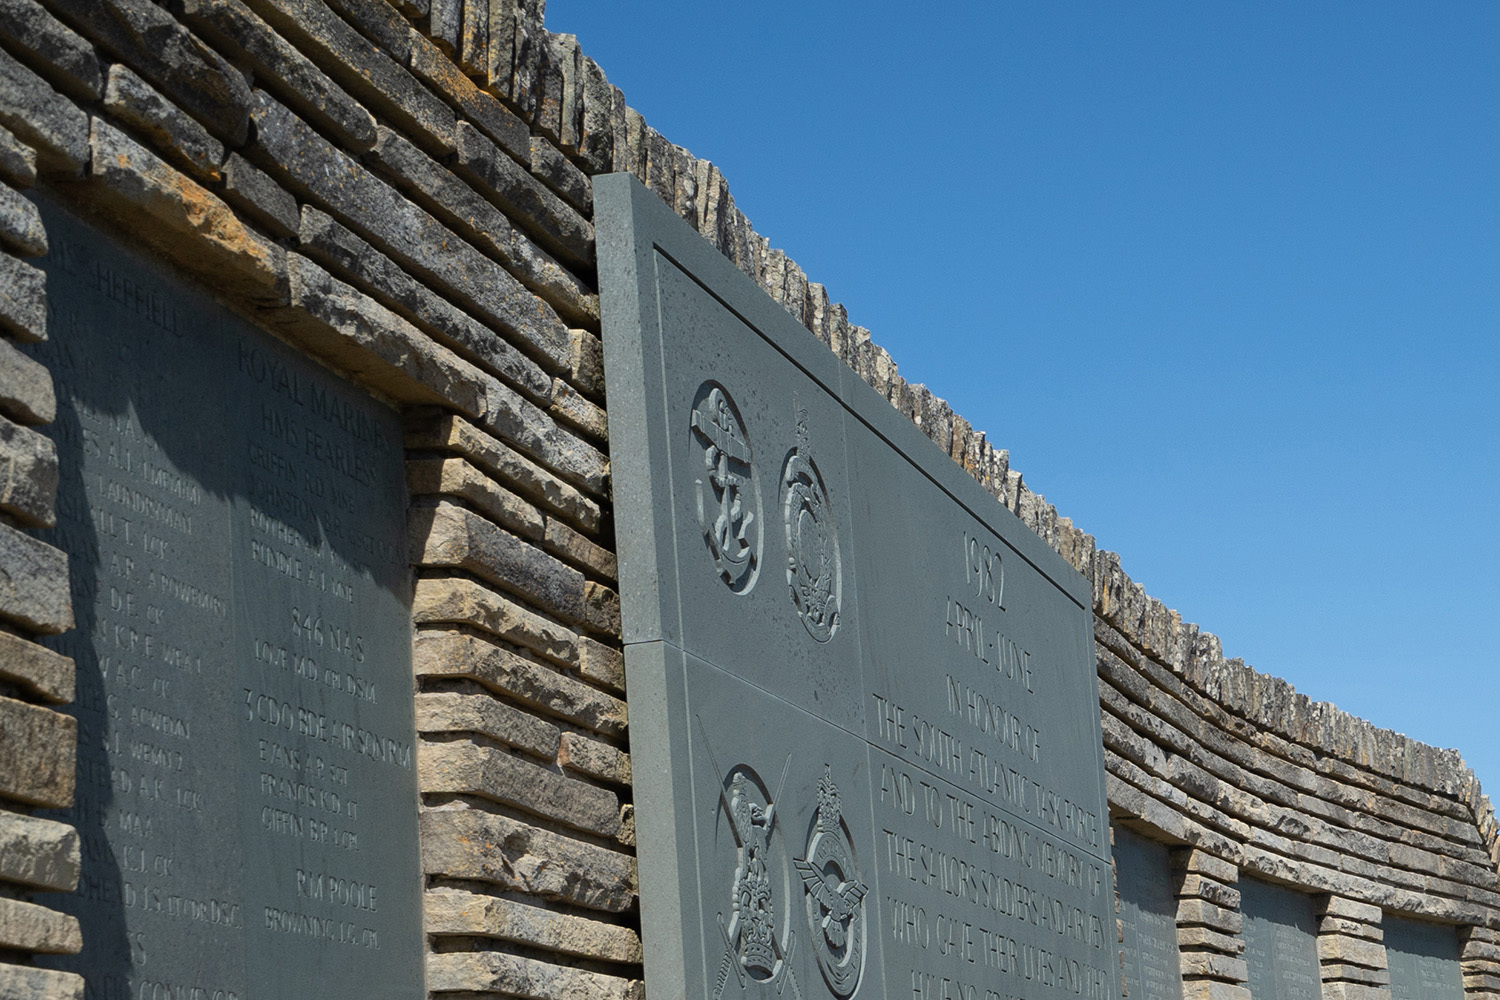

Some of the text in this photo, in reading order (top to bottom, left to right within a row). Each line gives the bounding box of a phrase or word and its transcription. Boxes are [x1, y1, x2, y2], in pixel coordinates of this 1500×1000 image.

[236, 337, 305, 408] ROYAL
[260, 400, 300, 450] HMS
[246, 438, 298, 484] GRIFFIN
[97, 471, 192, 535] LAUNDRYMAN
[250, 537, 304, 583] RUNDLE
[962, 529, 1008, 613] 1982
[253, 635, 289, 674] LOVE
[290, 604, 367, 666] 846 NAS
[944, 594, 989, 666] APRIL
[995, 630, 1036, 696] JUNE
[242, 686, 255, 723] 3
[255, 692, 296, 733] CDO
[297, 704, 328, 745] BDE
[330, 719, 357, 757] AIR
[387, 738, 413, 772] RM
[945, 672, 1041, 764] IN HONOUR OF
[257, 737, 302, 773] EVANS
[328, 763, 350, 788] SGT
[258, 770, 318, 810] FRANCIS
[871, 691, 1099, 849] THE SOUTH ATLANTIC TASK FORCE
[259, 803, 305, 839] GIFFIN
[880, 762, 1102, 898] AND TO THE ABIDING MEMORY OF
[294, 866, 379, 914] RM POOLE
[881, 826, 1107, 951] THE SAILORS SOLDIERS AND AIRMEN
[262, 904, 335, 942] BROWNING
[886, 895, 931, 951] WHO
[935, 912, 977, 965] GAVE
[977, 926, 1021, 978] THEIR
[1021, 941, 1057, 989] LIVES
[1057, 955, 1083, 997] AND
